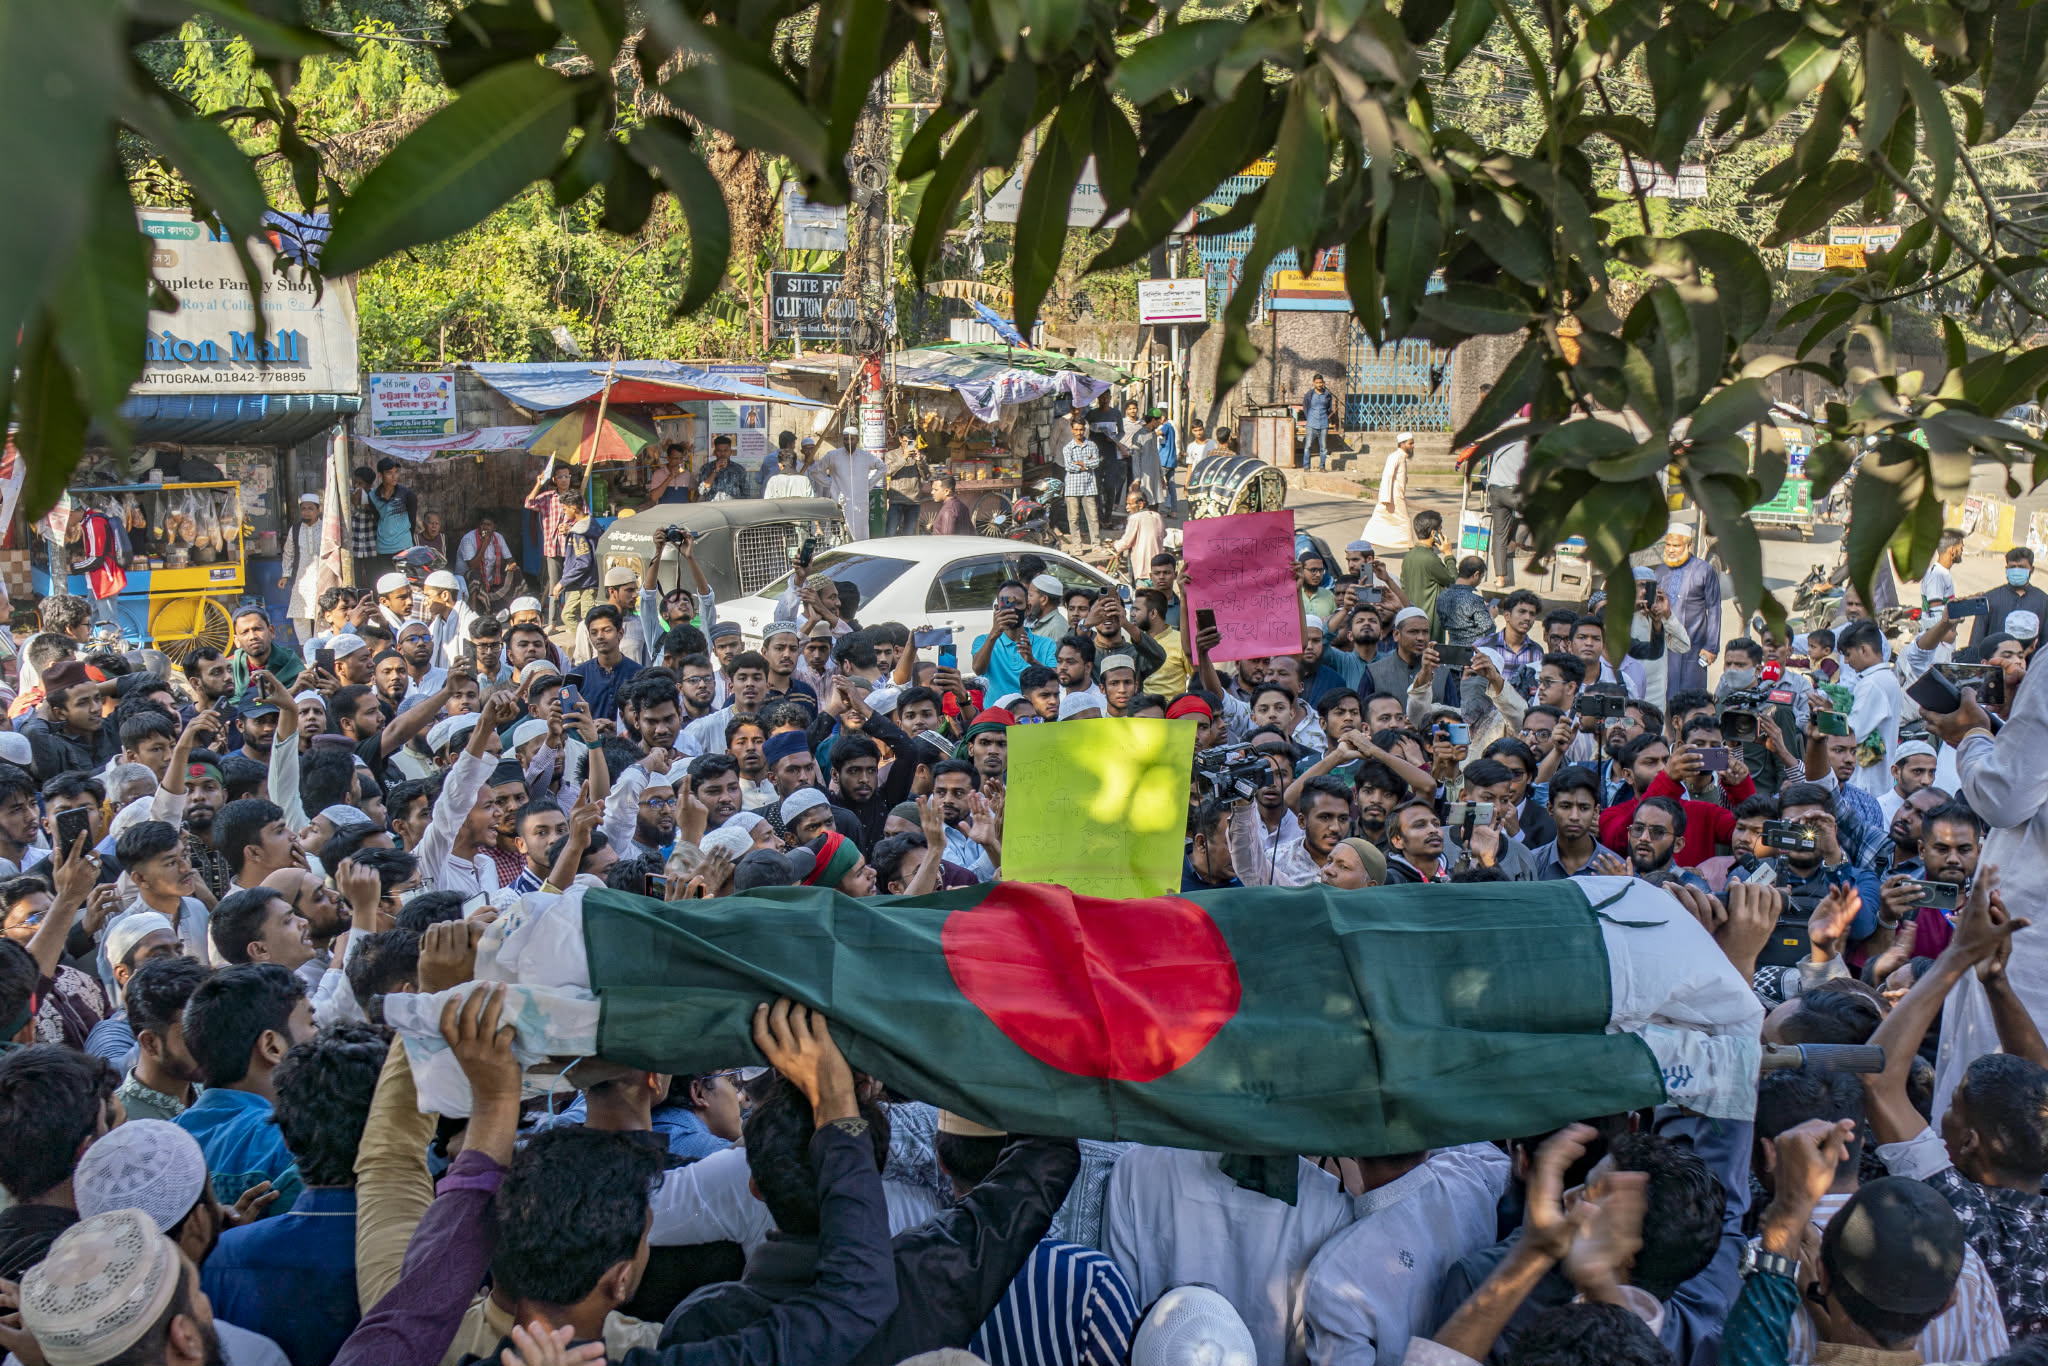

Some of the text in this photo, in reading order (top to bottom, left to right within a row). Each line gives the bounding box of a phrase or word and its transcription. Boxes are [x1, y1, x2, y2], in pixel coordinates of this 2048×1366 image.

[147, 276, 214, 292] omplete
[787, 278, 842, 294] SITE FO
[181, 298, 217, 313] Royal
[775, 296, 823, 318] CLIFTON
[228, 328, 300, 362] Mall
[214, 371, 307, 384] 01842-778895
